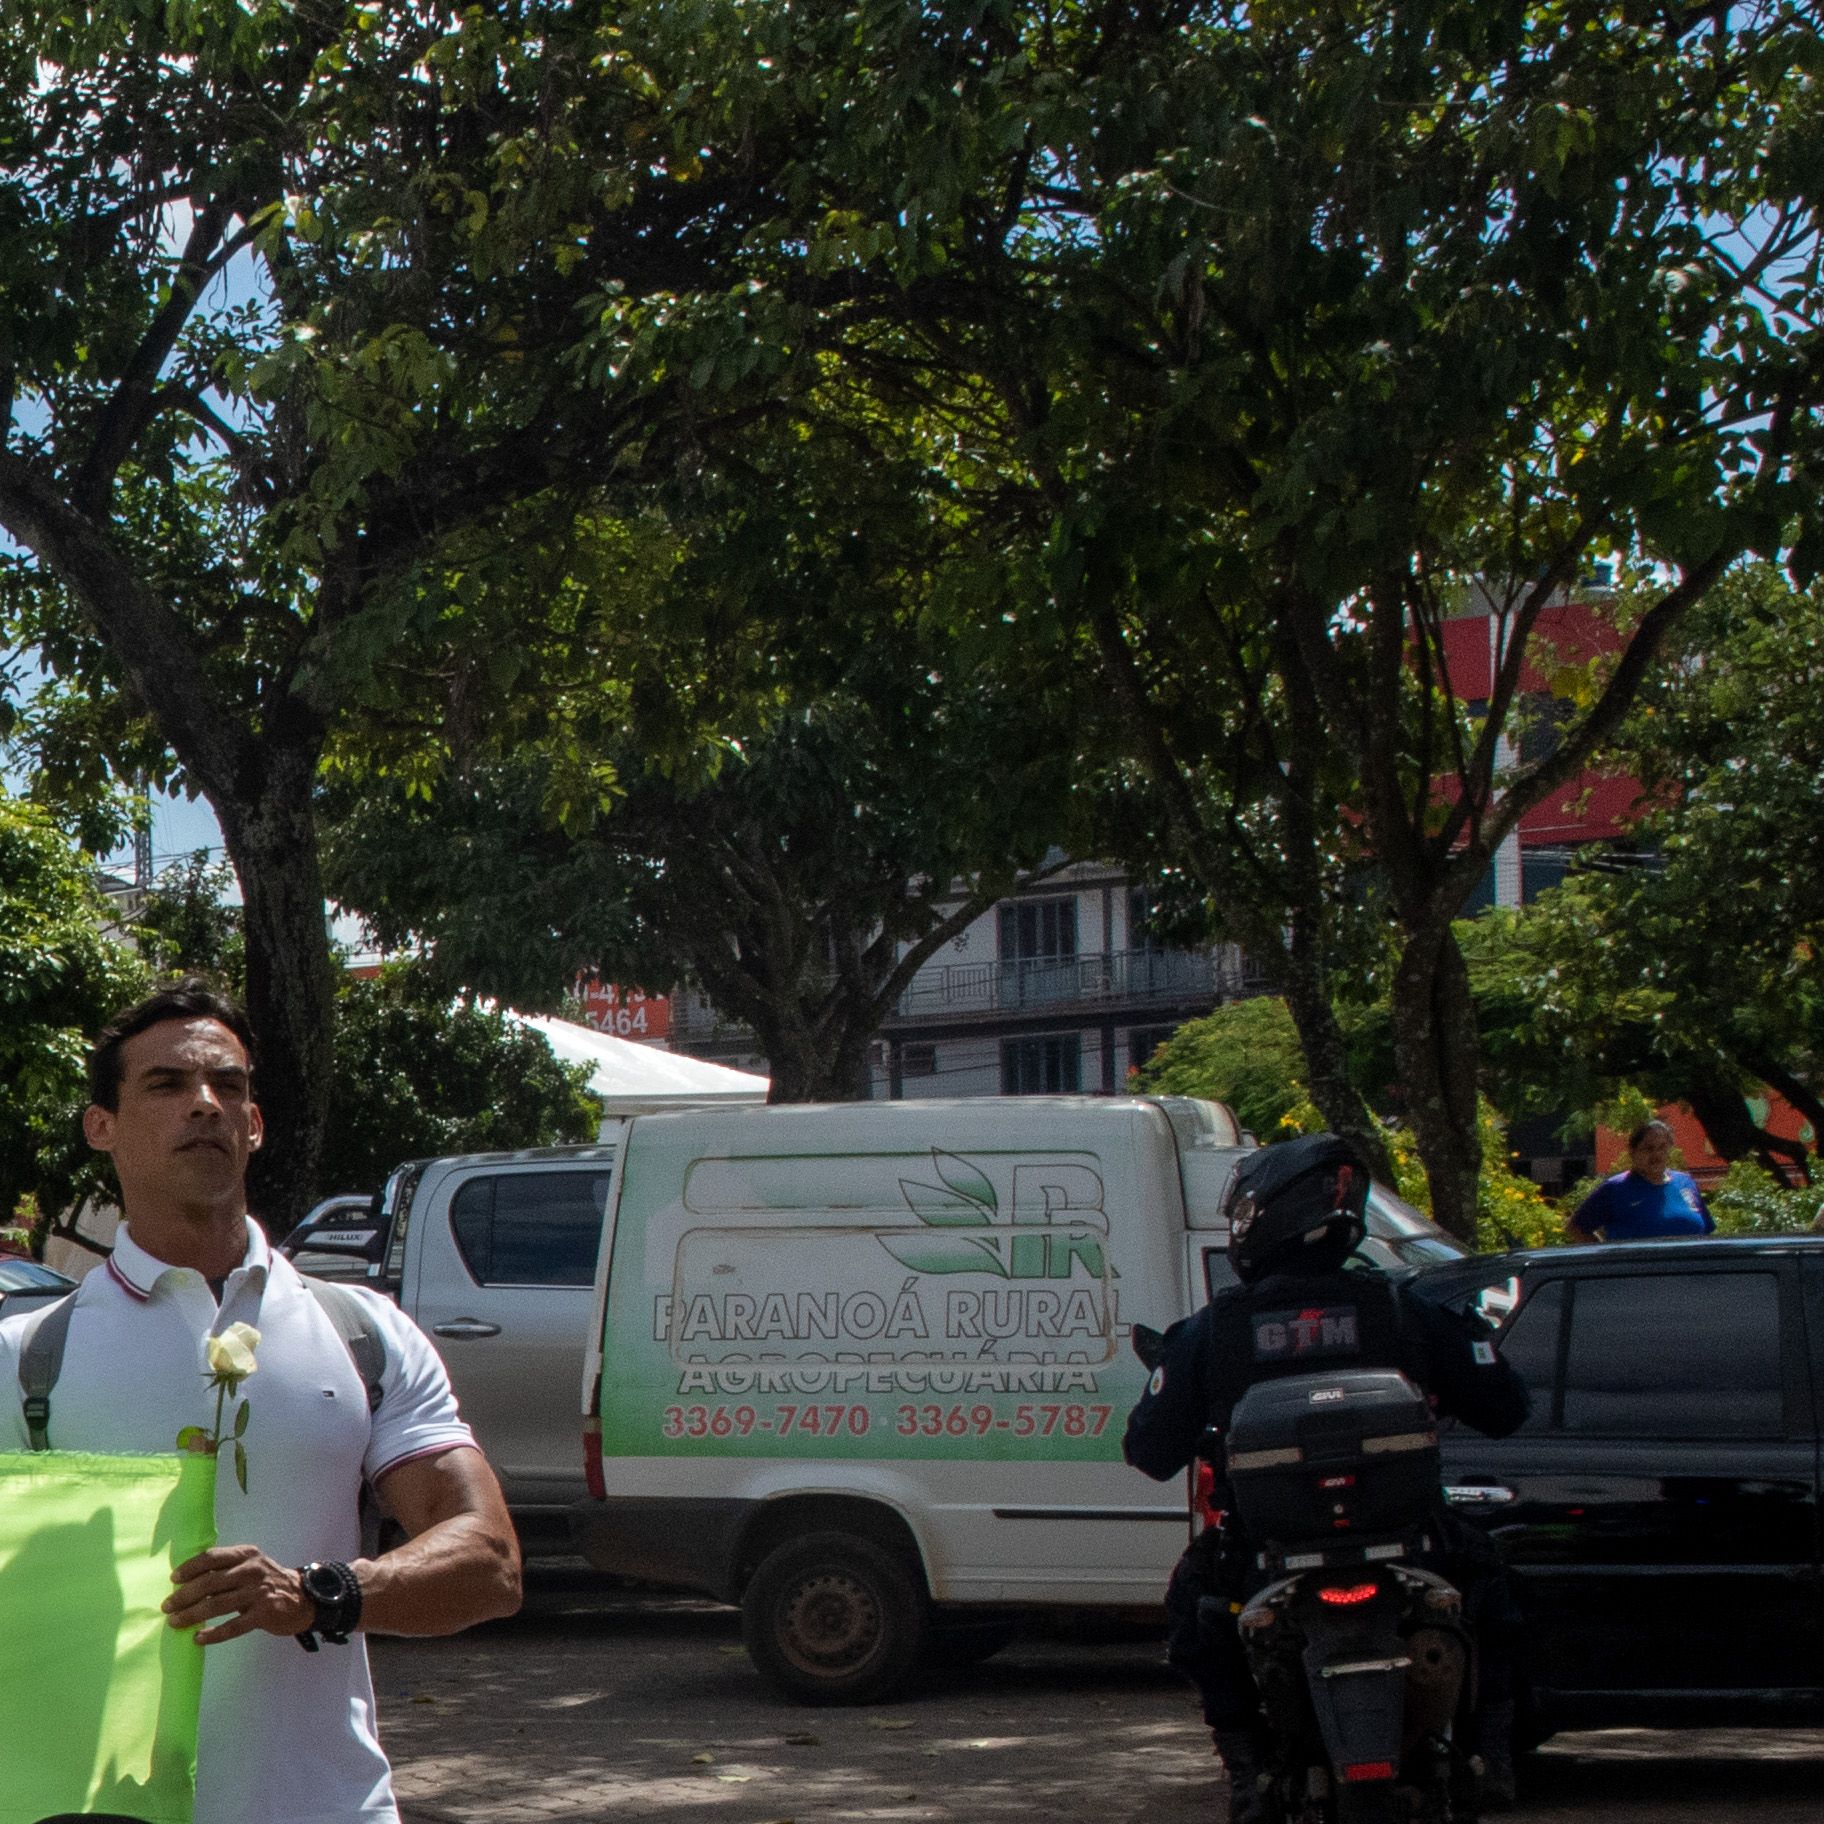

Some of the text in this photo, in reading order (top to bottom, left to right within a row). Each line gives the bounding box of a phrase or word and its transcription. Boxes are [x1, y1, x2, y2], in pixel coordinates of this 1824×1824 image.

[329, 1233, 361, 1241] HILUX
[653, 1276, 1133, 1341] PARANOÁ RURAL
[1256, 1315, 1357, 1351] GTM
[677, 1339, 1098, 1394] AGROPECUÁRIA
[663, 1403, 1113, 1438] 3369-7470 3369-5787
